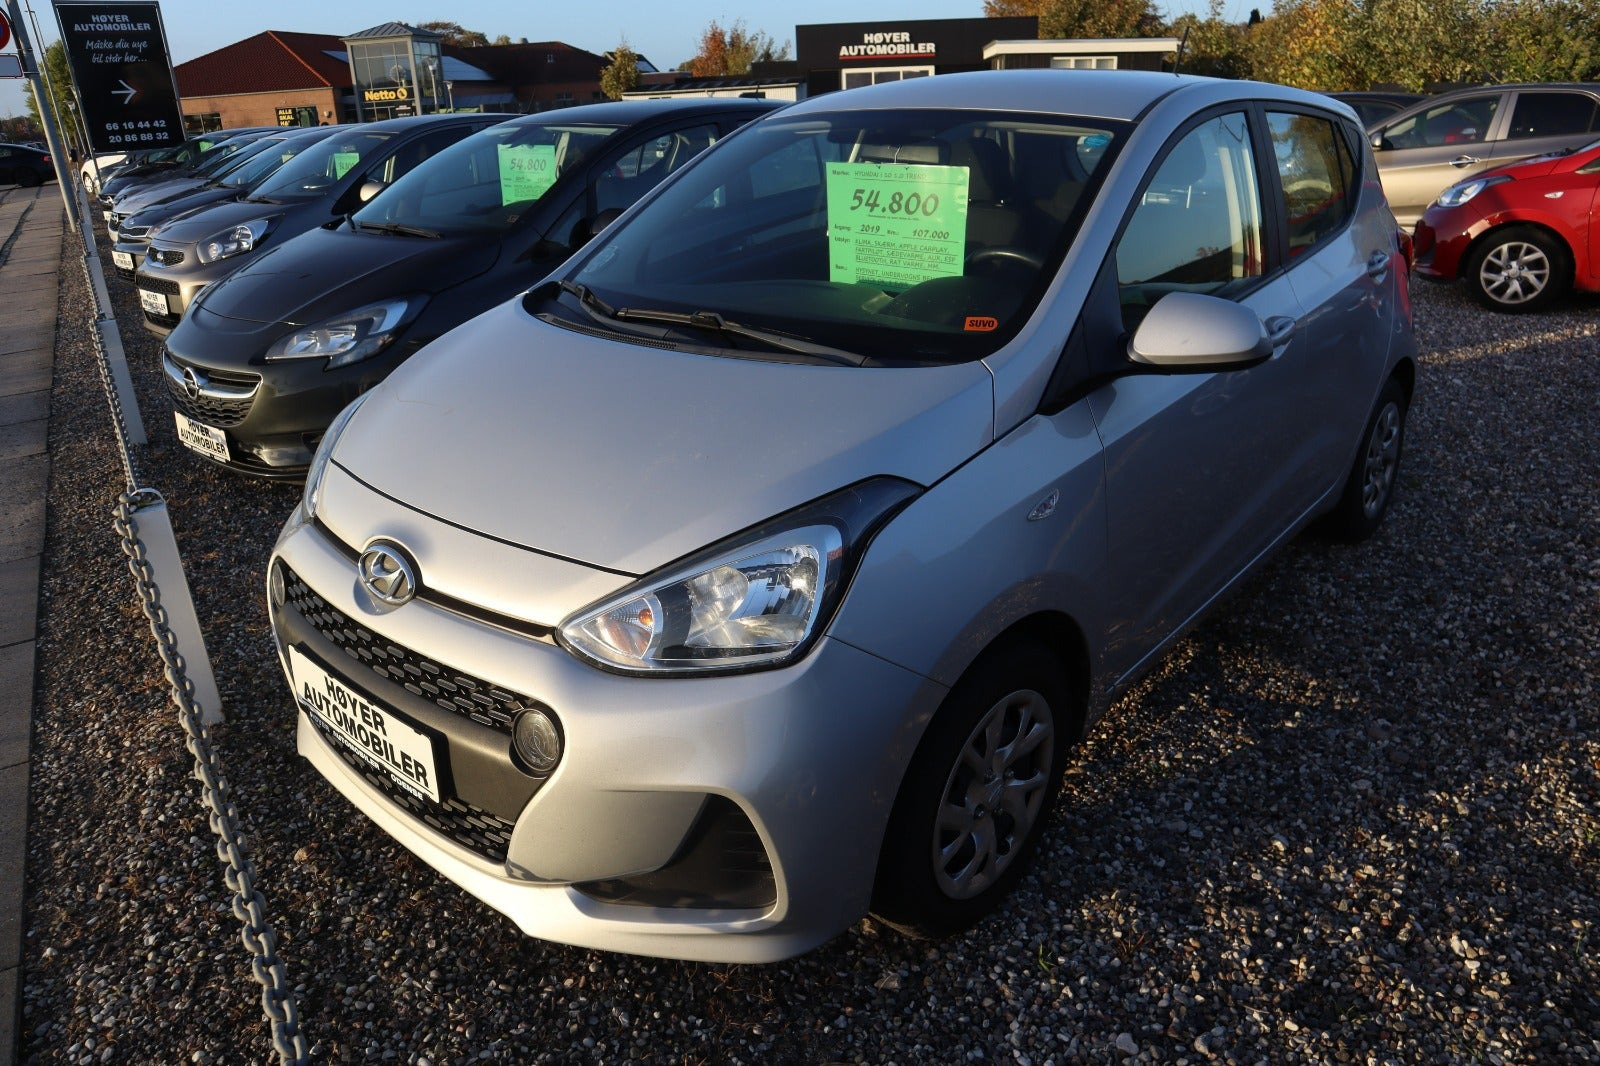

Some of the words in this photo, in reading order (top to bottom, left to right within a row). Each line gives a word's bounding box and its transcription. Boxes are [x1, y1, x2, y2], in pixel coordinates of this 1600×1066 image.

[91, 14, 129, 23] HØYER
[74, 23, 151, 31] AUTOMOBILER
[863, 32, 910, 44] HØYER
[85, 39, 113, 50] Måske
[115, 38, 129, 49] din
[131, 41, 148, 52] nye
[839, 43, 936, 56] AUTOMOBILER
[91, 53, 103, 63] bil
[105, 52, 122, 62] står
[364, 90, 396, 101] Netto
[122, 122, 134, 130] 16
[137, 121, 150, 129] 44
[152, 120, 166, 128] 42
[109, 135, 122, 143] 20
[125, 134, 138, 142] 86
[140, 133, 153, 141] 88
[155, 132, 169, 140] 32
[510, 158, 547, 171] 54.800
[850, 188, 939, 217] 54.800
[860, 224, 880, 233] 2019
[912, 229, 950, 239] 107.000
[968, 319, 995, 328] SUVO
[180, 428, 227, 455] AUTOMOBILER
[324, 675, 387, 736] HØYER
[303, 681, 429, 788] AUTOMOBILER
[332, 730, 380, 770] AUTOMOBILER
[390, 773, 424, 801] ODENSE
